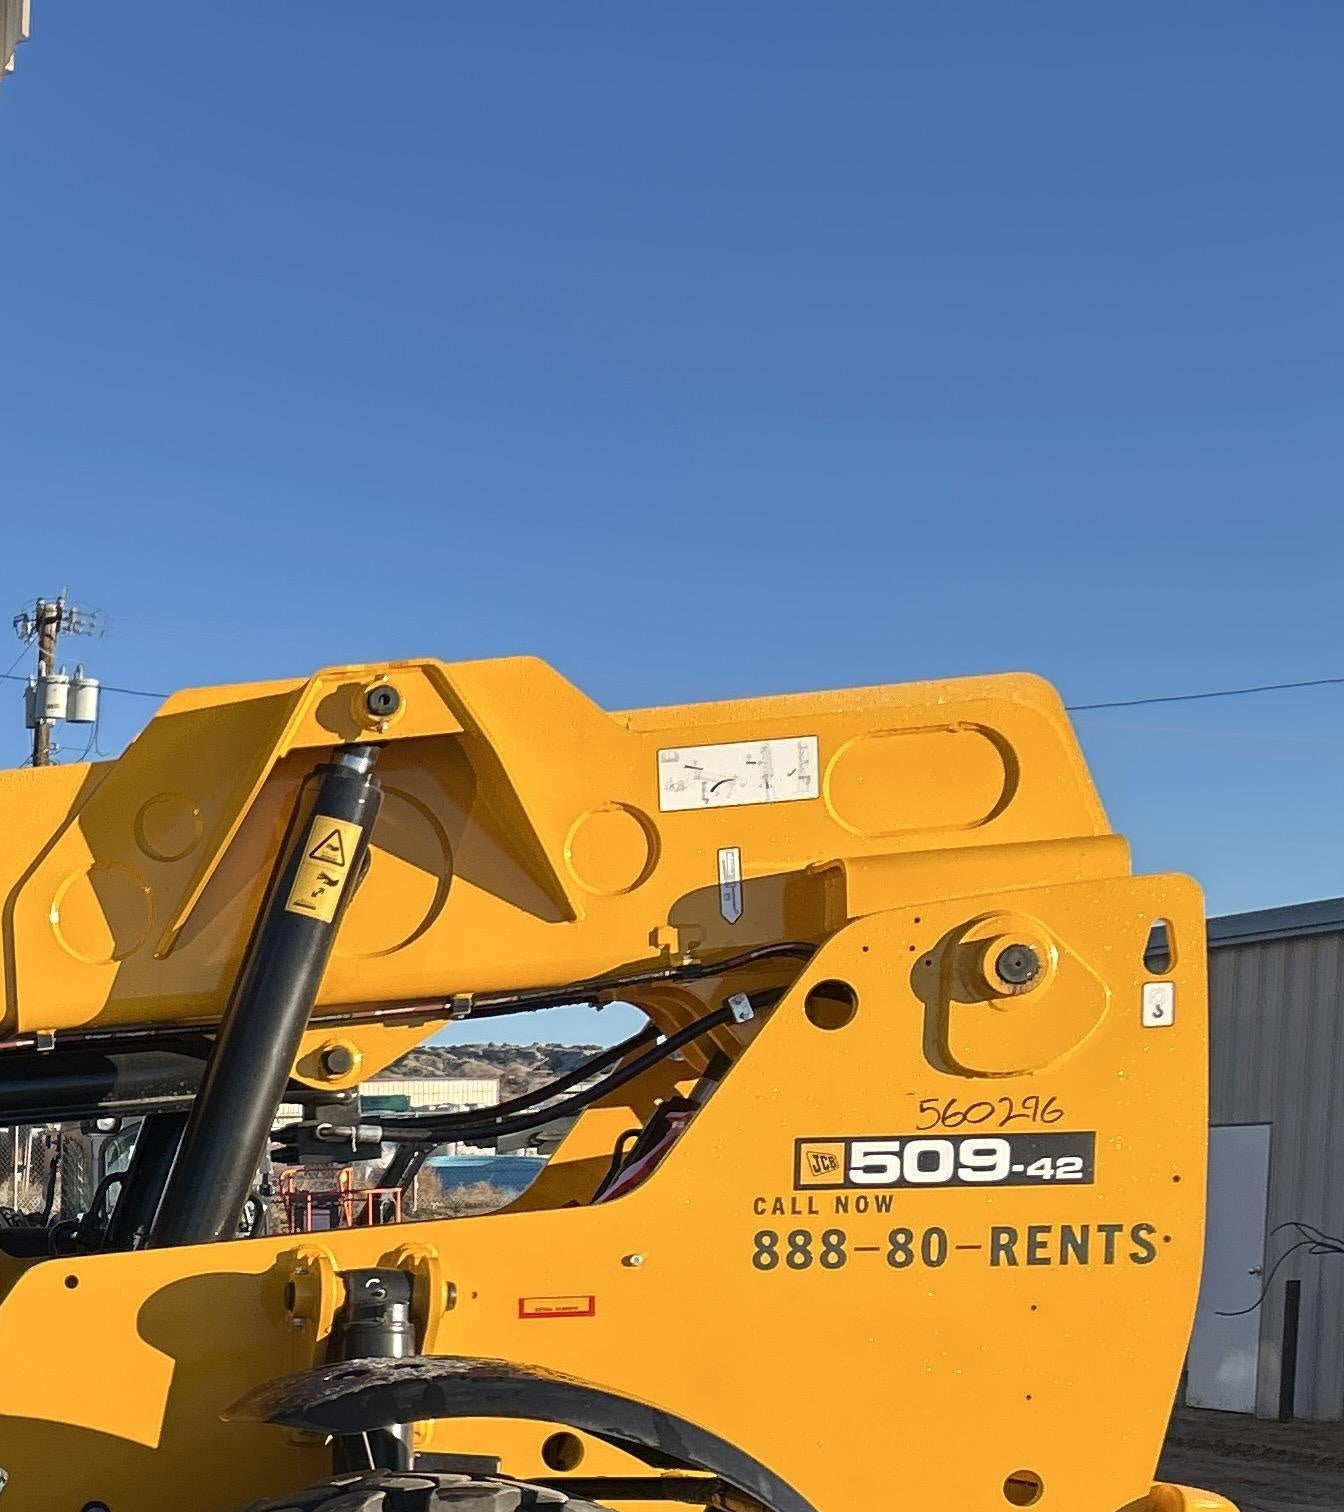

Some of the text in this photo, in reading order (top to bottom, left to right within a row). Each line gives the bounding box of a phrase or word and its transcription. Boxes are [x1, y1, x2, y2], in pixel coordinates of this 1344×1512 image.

[916, 1095, 1064, 1130] 560296
[811, 1152, 838, 1174] JCB
[849, 1138, 1084, 1185] 509-42
[753, 1194, 895, 1216] CALL NOW
[751, 1223, 1158, 1271] 888-80-RENTS
